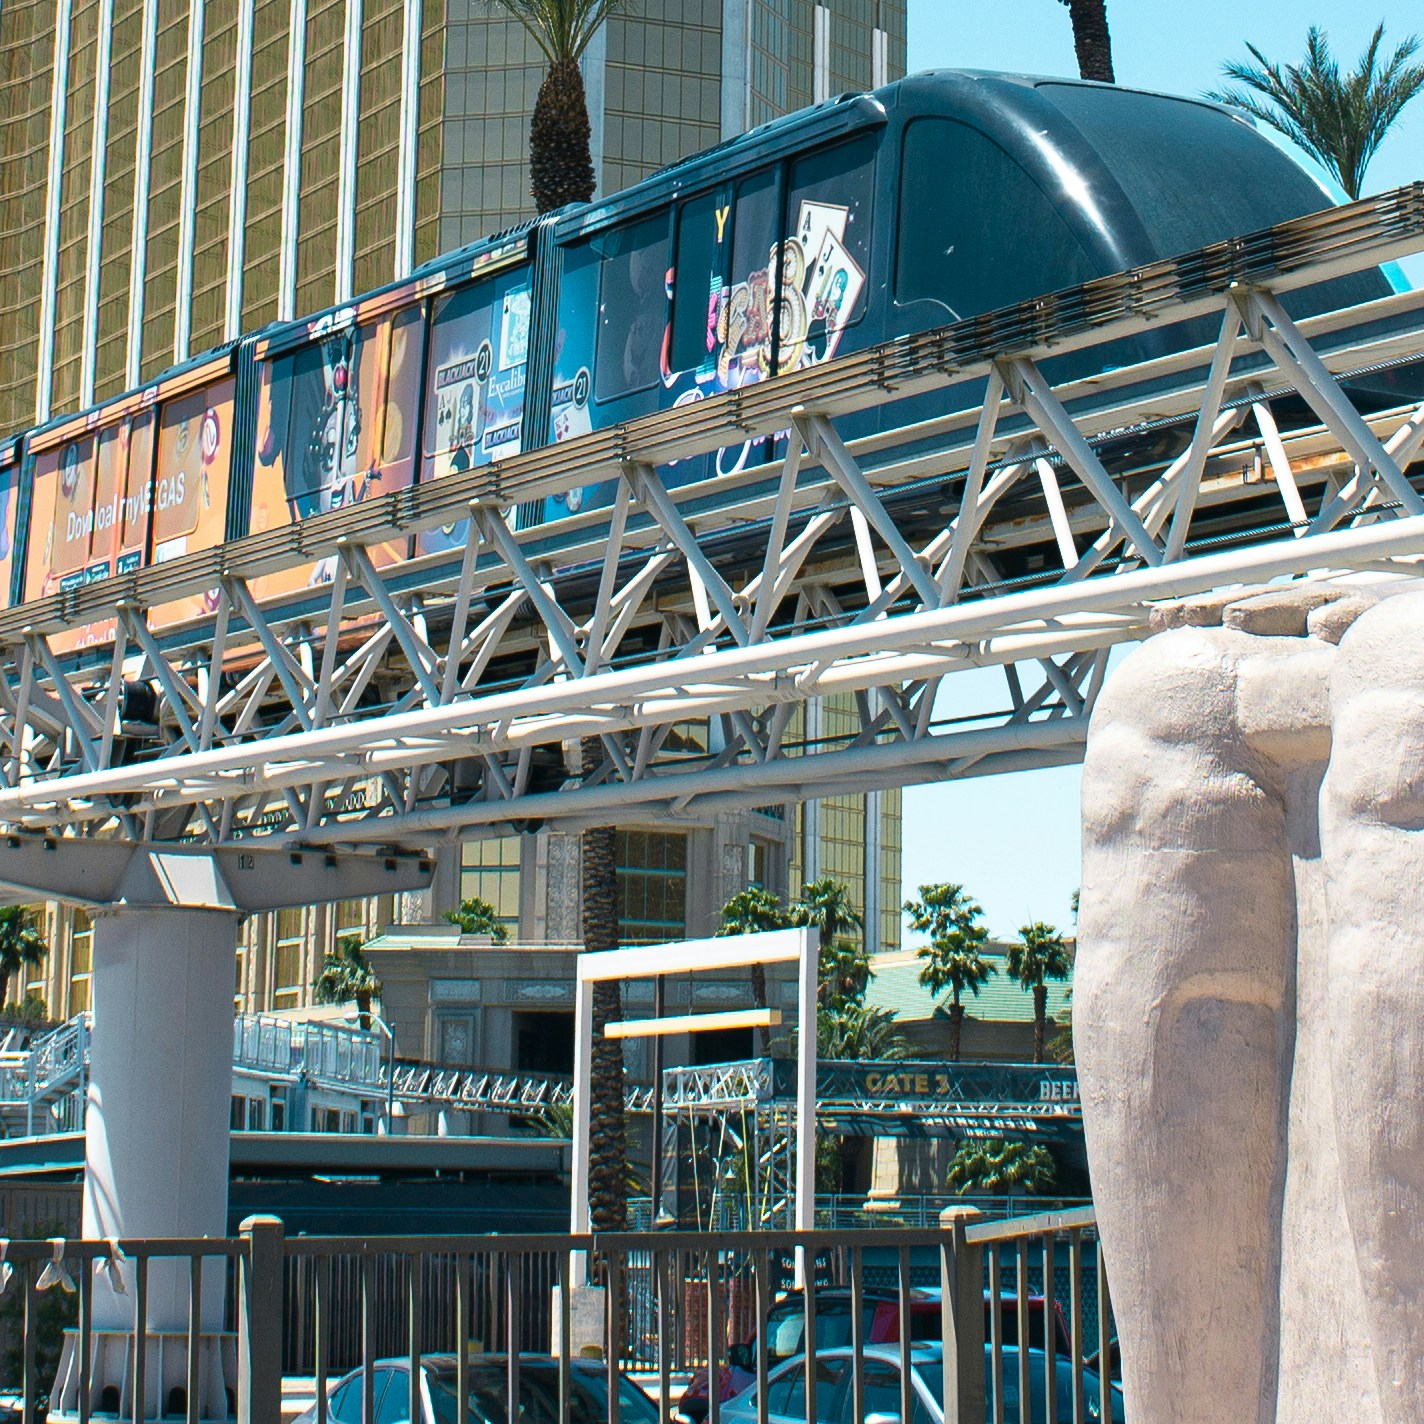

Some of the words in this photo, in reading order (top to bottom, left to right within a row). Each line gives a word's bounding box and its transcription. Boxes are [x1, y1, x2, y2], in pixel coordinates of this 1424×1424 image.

[478, 350, 490, 375] 21
[576, 376, 587, 399] 21
[865, 1072, 930, 1094] GATE
[935, 1073, 950, 1094] 3
